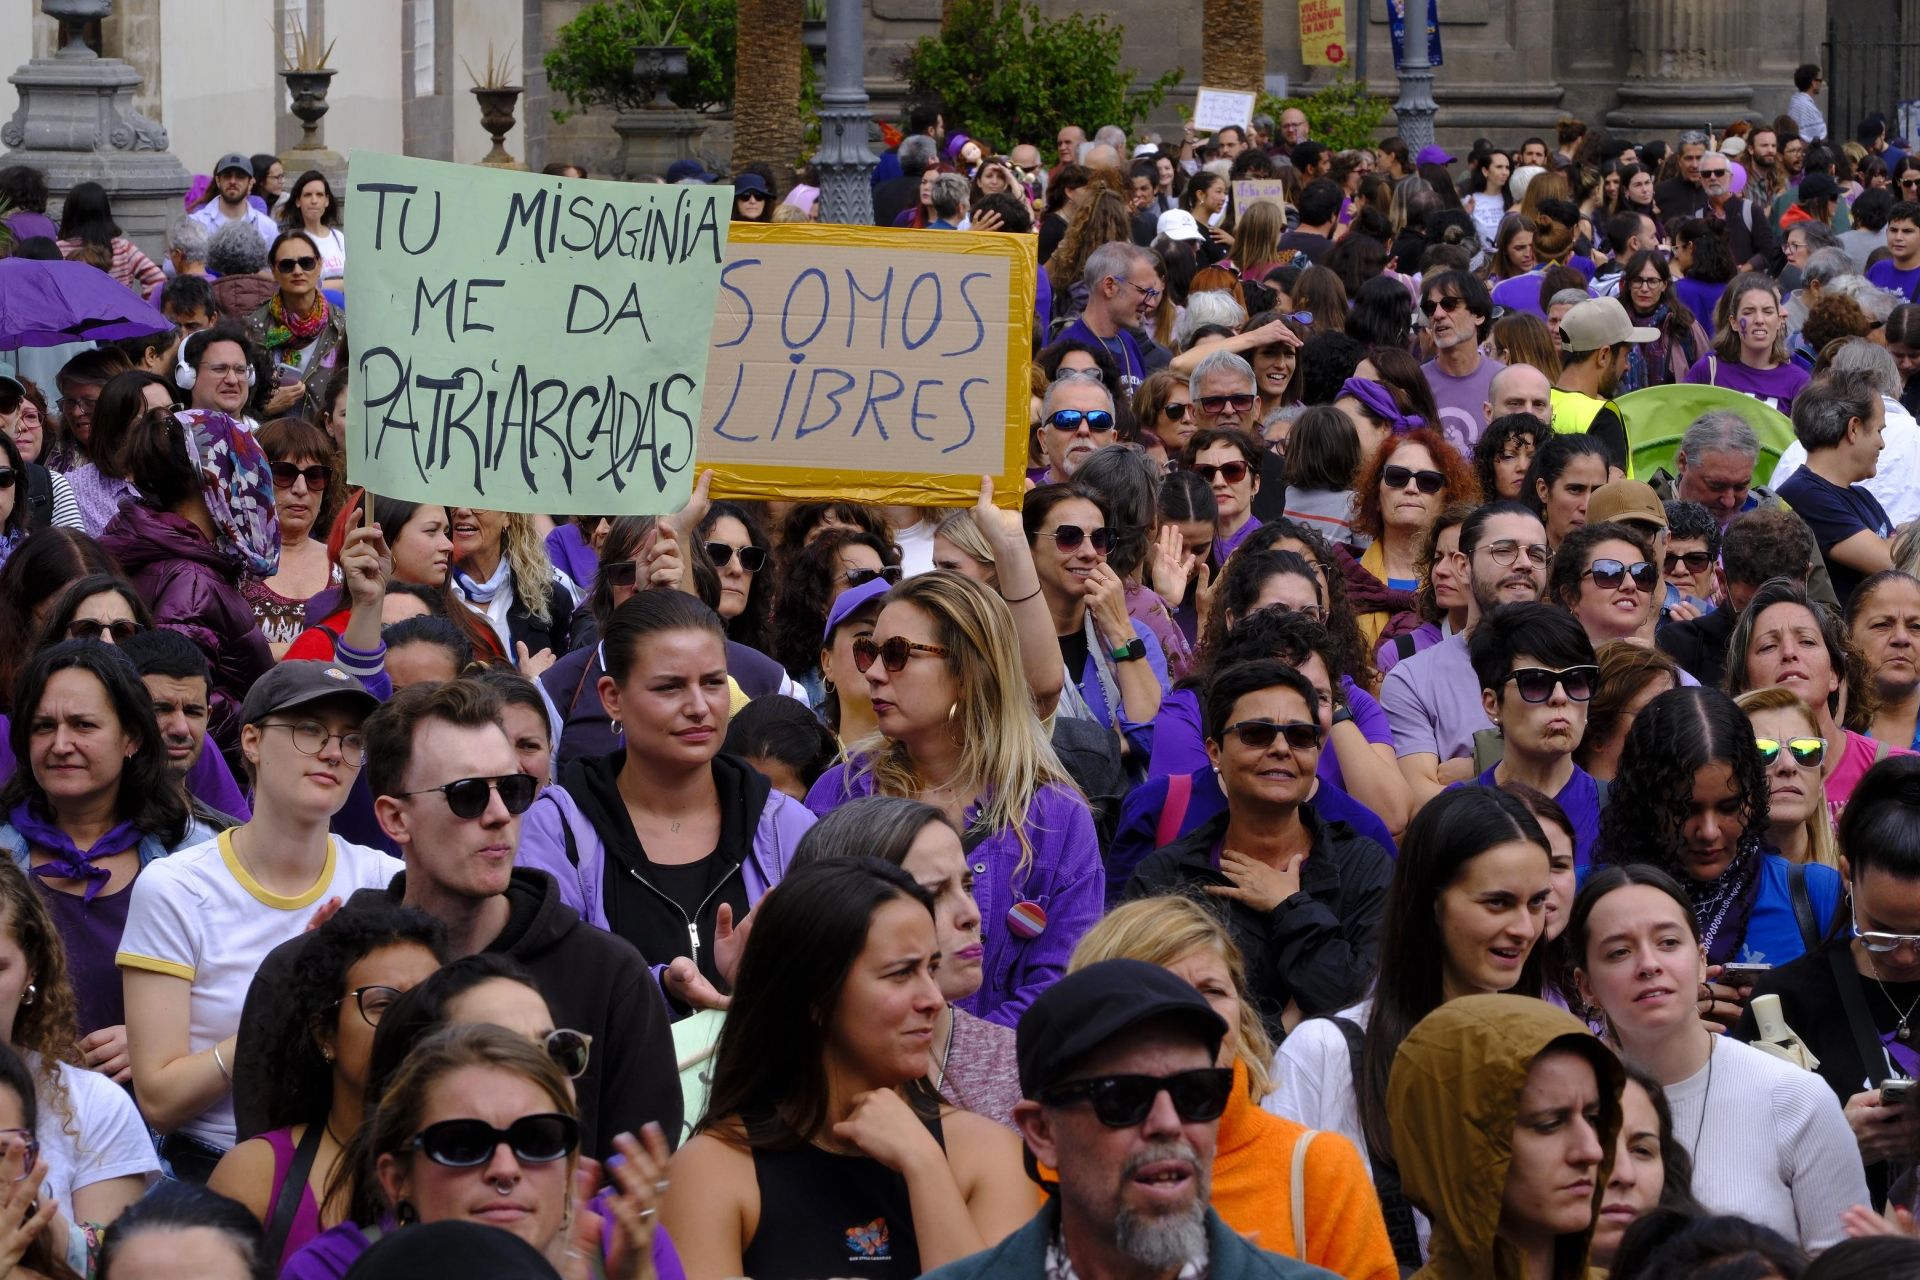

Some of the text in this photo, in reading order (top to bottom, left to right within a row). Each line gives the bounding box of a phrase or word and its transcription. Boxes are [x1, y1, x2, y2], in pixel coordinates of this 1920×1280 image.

[356, 182, 441, 256] TU
[411, 276, 652, 343] ME DA
[714, 258, 992, 357] SOMOS
